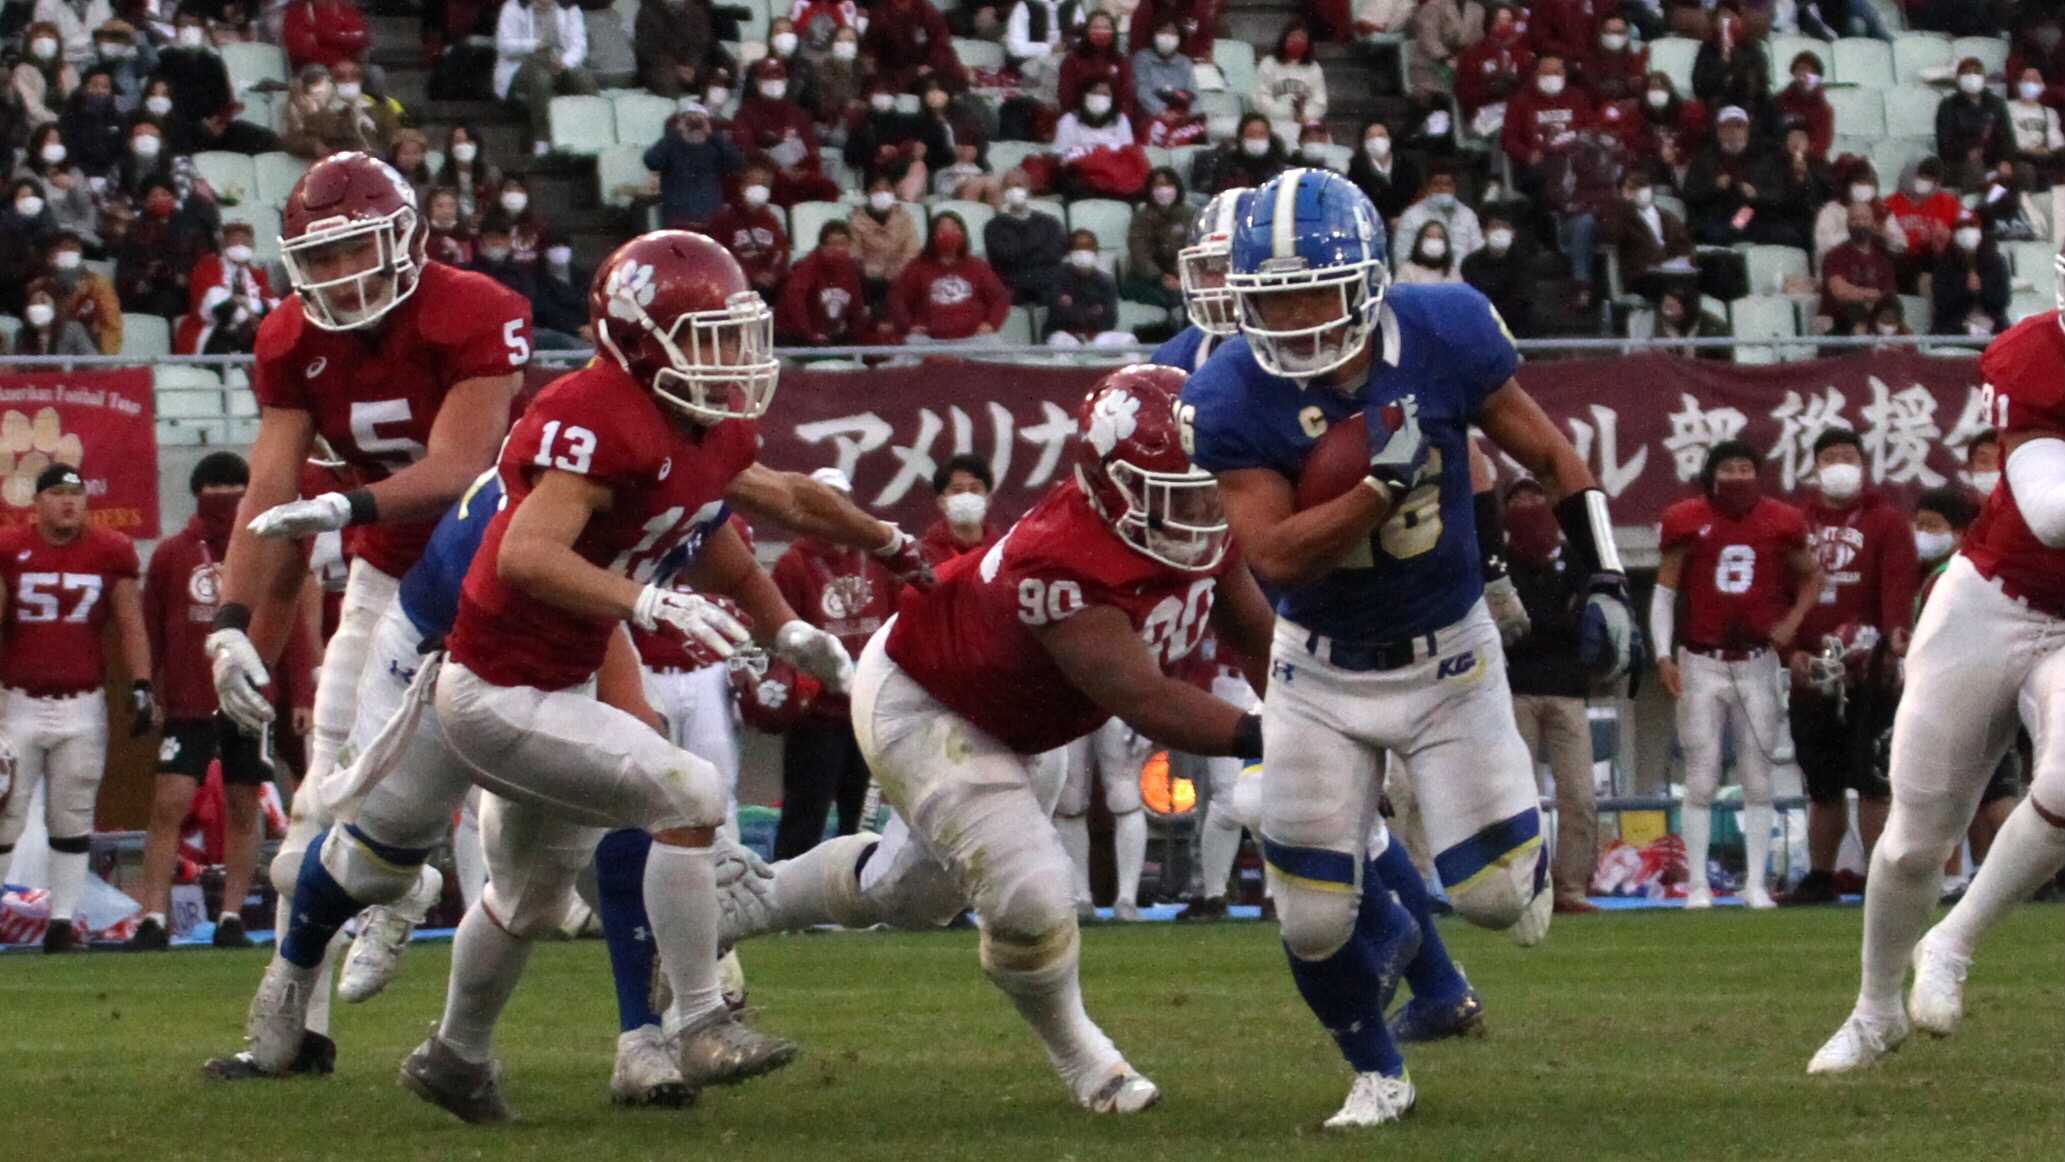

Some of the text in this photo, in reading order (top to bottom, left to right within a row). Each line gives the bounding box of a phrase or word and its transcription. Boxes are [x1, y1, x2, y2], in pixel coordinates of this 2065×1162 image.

[503, 318, 530, 366] 5
[1171, 399, 1197, 457] 6
[1298, 405, 1328, 439] C
[533, 420, 598, 475] 13
[1715, 544, 1757, 593] 8
[18, 572, 103, 624] 57
[1017, 577, 1087, 625] 90
